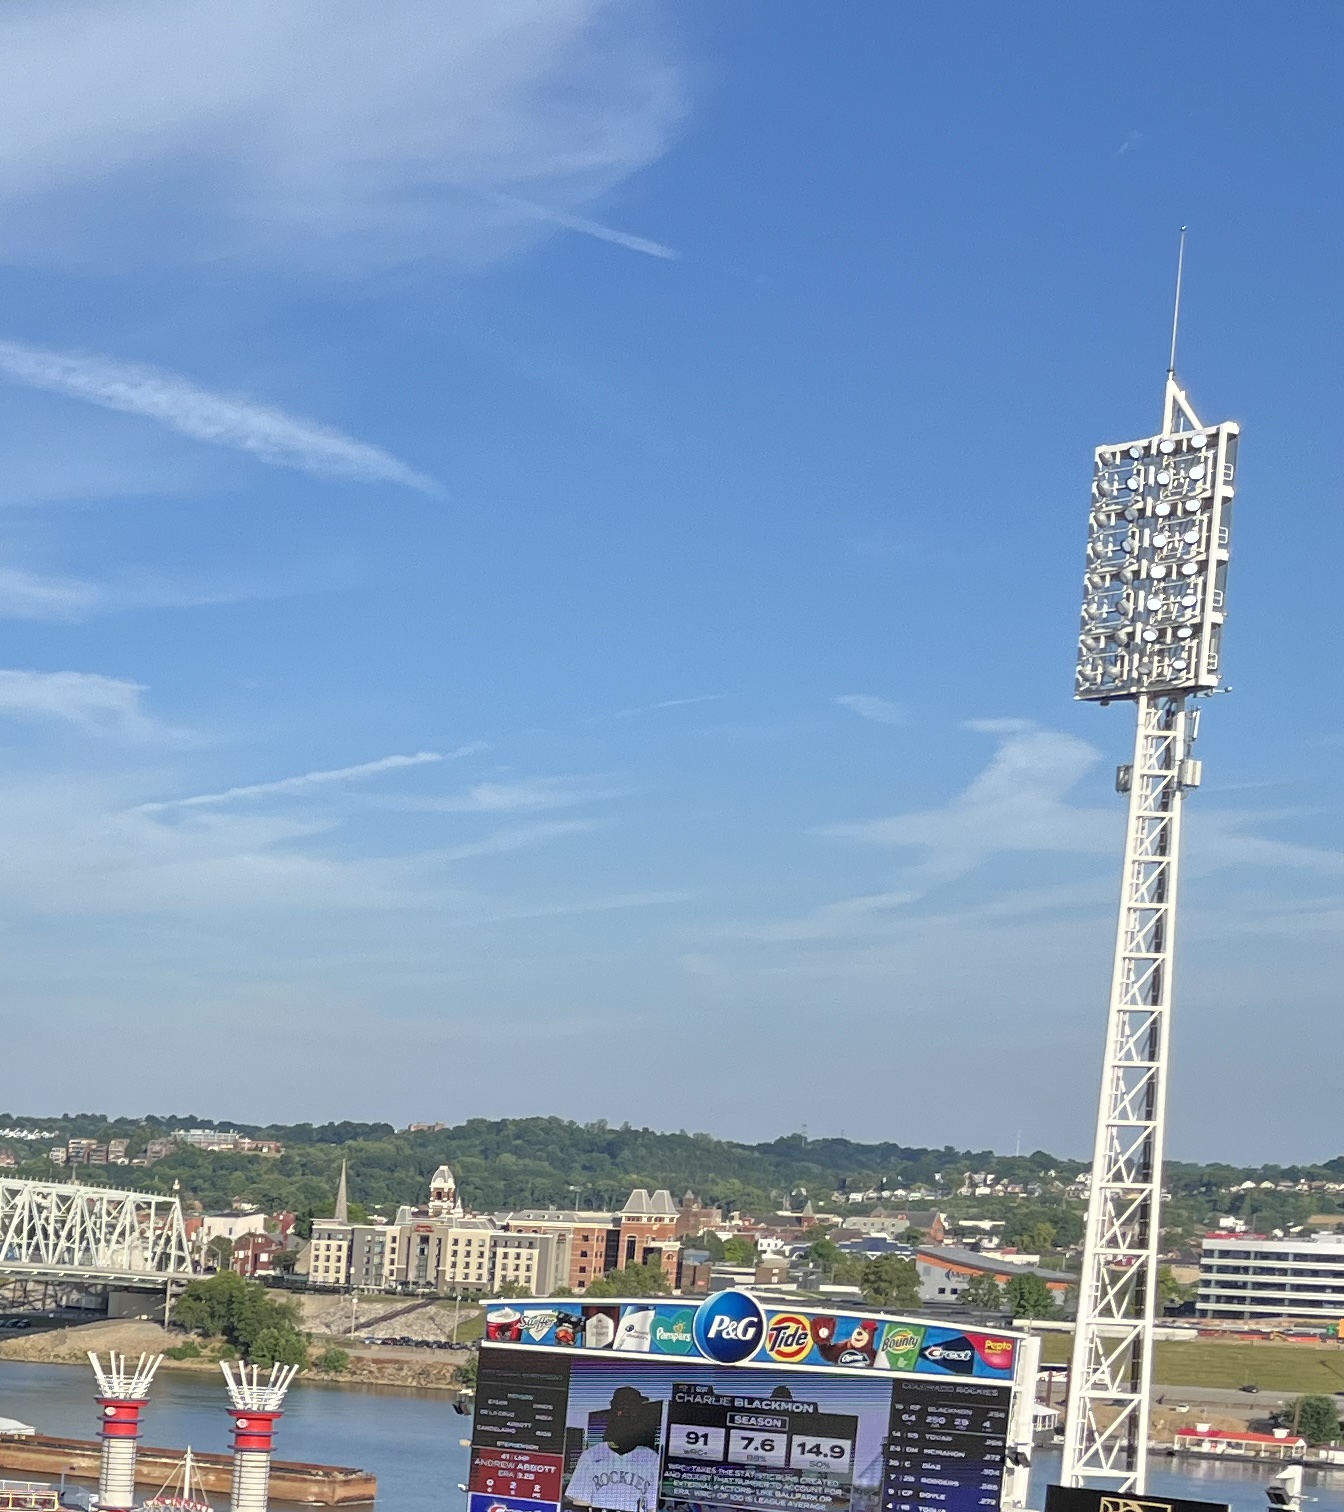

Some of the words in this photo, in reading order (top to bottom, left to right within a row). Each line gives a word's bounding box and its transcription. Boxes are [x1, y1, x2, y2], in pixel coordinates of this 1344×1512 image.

[656, 1327, 692, 1343] Pampers
[708, 1316, 758, 1342] P&G
[767, 1325, 809, 1354] Tide
[881, 1336, 919, 1351] Bounty
[984, 1340, 1012, 1351] Pepto
[926, 1346, 972, 1361] Crest
[675, 1393, 732, 1407] CHARLIE
[734, 1398, 814, 1413] BLACKMON
[734, 1415, 782, 1428] SEASON
[685, 1431, 710, 1447] 91
[740, 1436, 776, 1452] 7.6
[796, 1442, 846, 1459] 14.9
[474, 1458, 515, 1469] ANDREW
[516, 1463, 557, 1474] ABBOTT
[592, 1470, 651, 1494] ROCKIES
